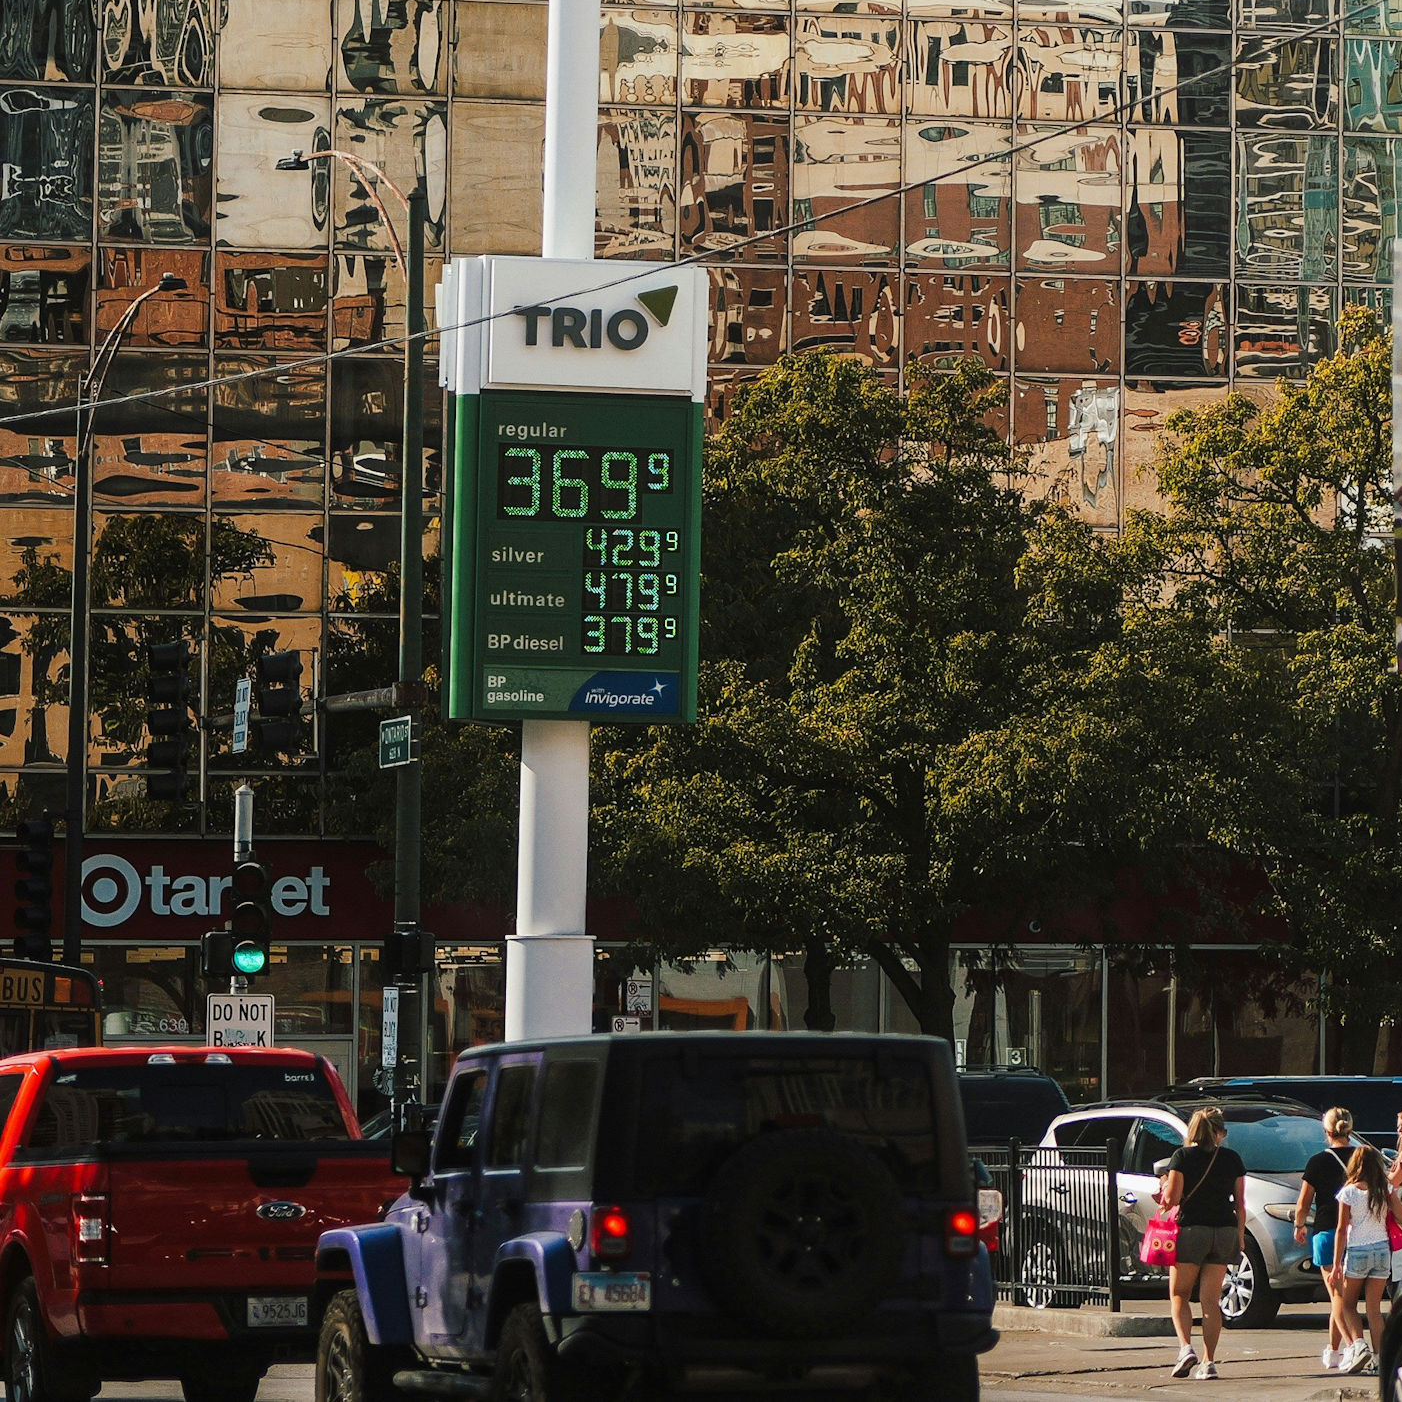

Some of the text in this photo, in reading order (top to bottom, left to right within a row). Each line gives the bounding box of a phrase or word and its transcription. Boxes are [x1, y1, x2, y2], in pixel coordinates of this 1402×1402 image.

[514, 305, 649, 351] TRIO
[498, 422, 567, 439] regular
[492, 546, 544, 563] silver
[490, 590, 565, 608] ultimate
[488, 634, 564, 651] BP diesel
[487, 675, 506, 688] BP
[487, 690, 544, 703] gasoline
[585, 691, 654, 707] Invigorate
[145, 865, 331, 916] taret
[3, 976, 42, 1000] BUS
[213, 1003, 268, 1021] DO NOT
[159, 1018, 187, 1033] 630
[1011, 1050, 1022, 1065] 3
[268, 1205, 295, 1217] Ford
